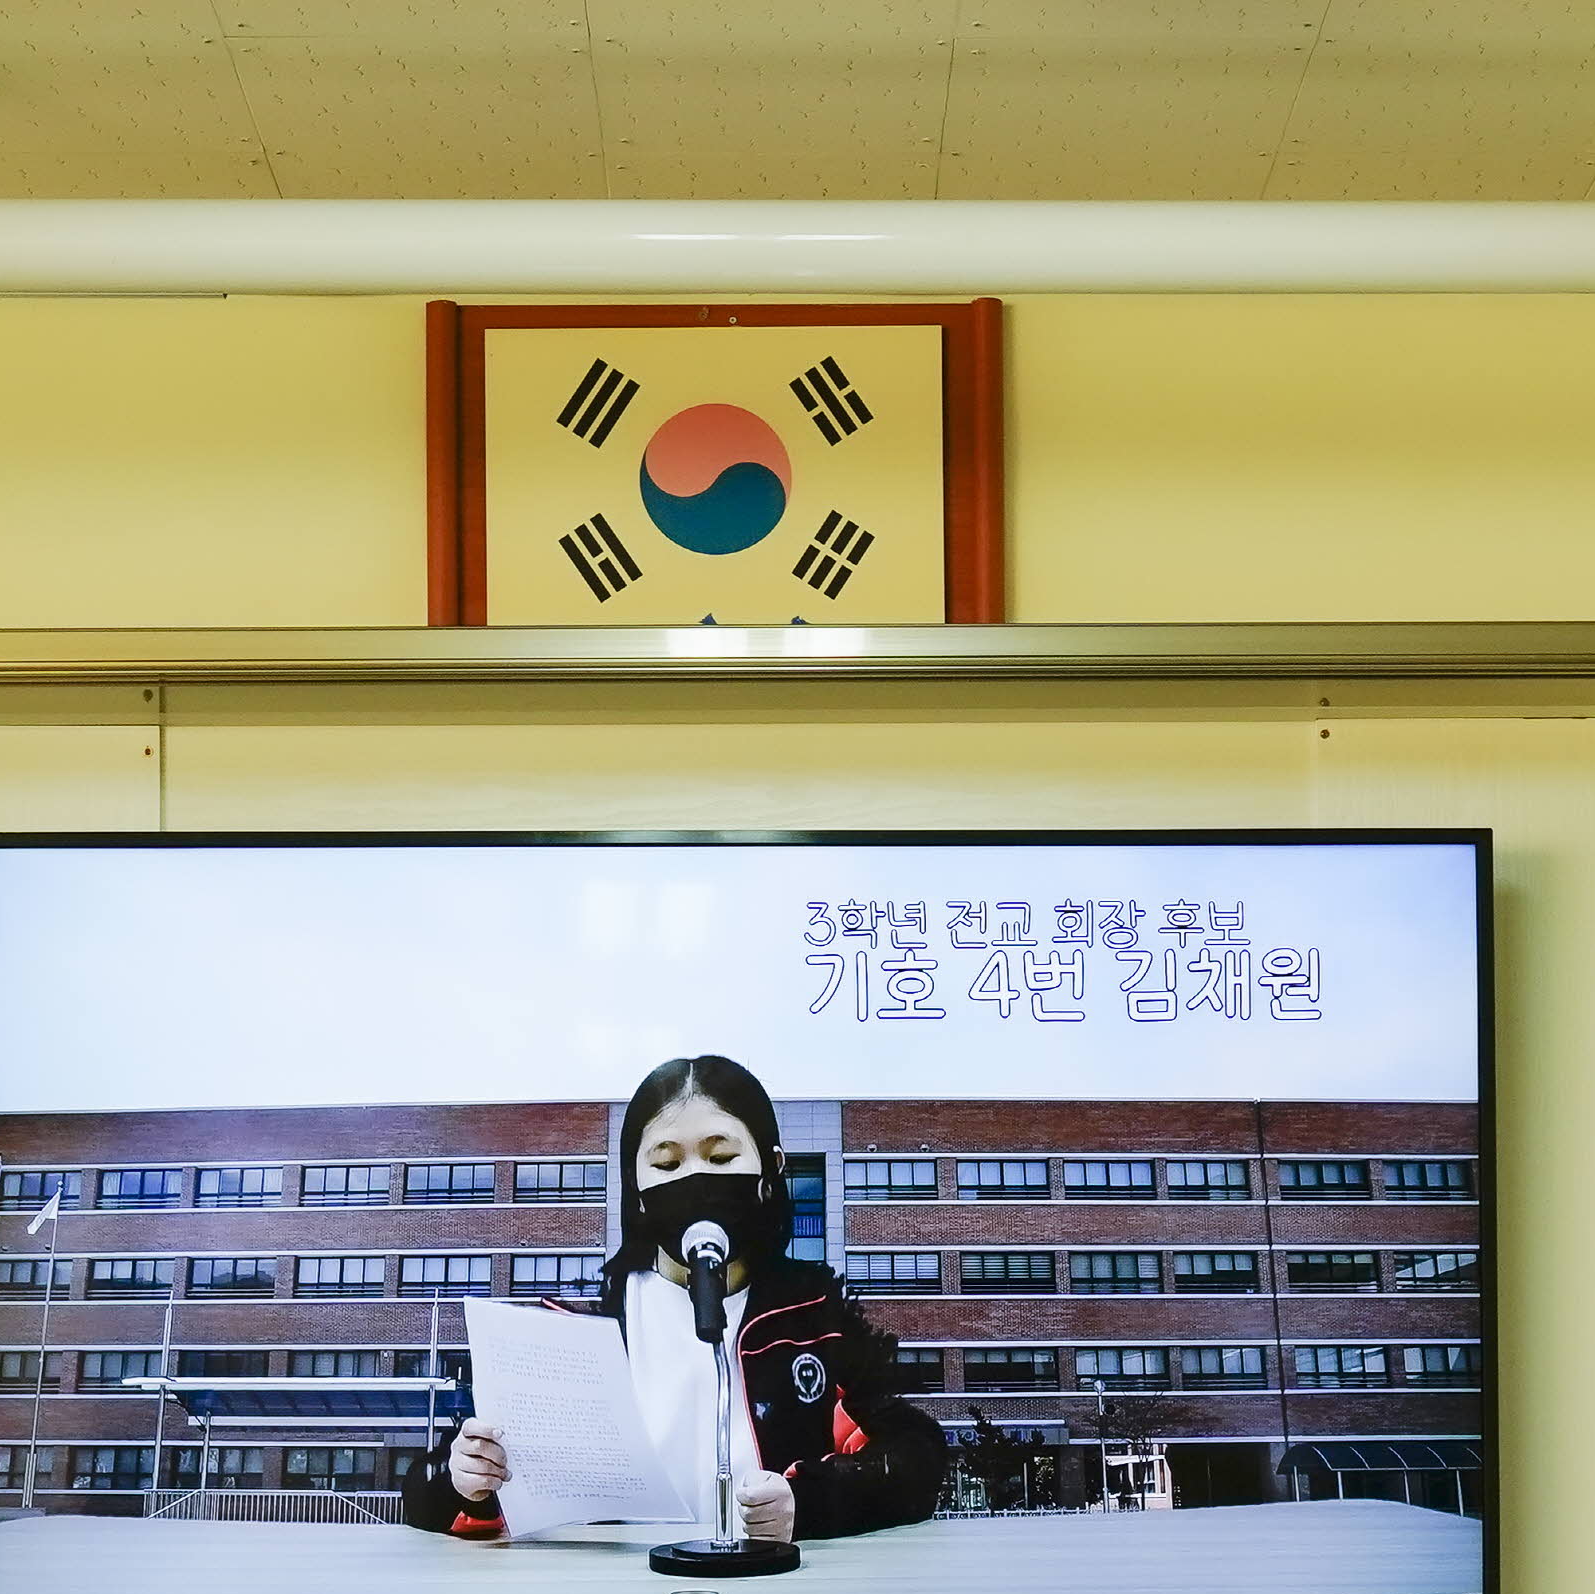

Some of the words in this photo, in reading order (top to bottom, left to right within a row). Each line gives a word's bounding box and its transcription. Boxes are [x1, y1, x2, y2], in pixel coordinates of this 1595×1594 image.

[803, 898, 929, 950] 3학년
[945, 898, 1039, 949] 전교
[1052, 898, 1146, 950] 회장
[1157, 898, 1252, 948] 후보
[804, 948, 947, 1022] 기호
[967, 949, 1087, 1022] 4번
[1114, 947, 1323, 1022] 김채원
